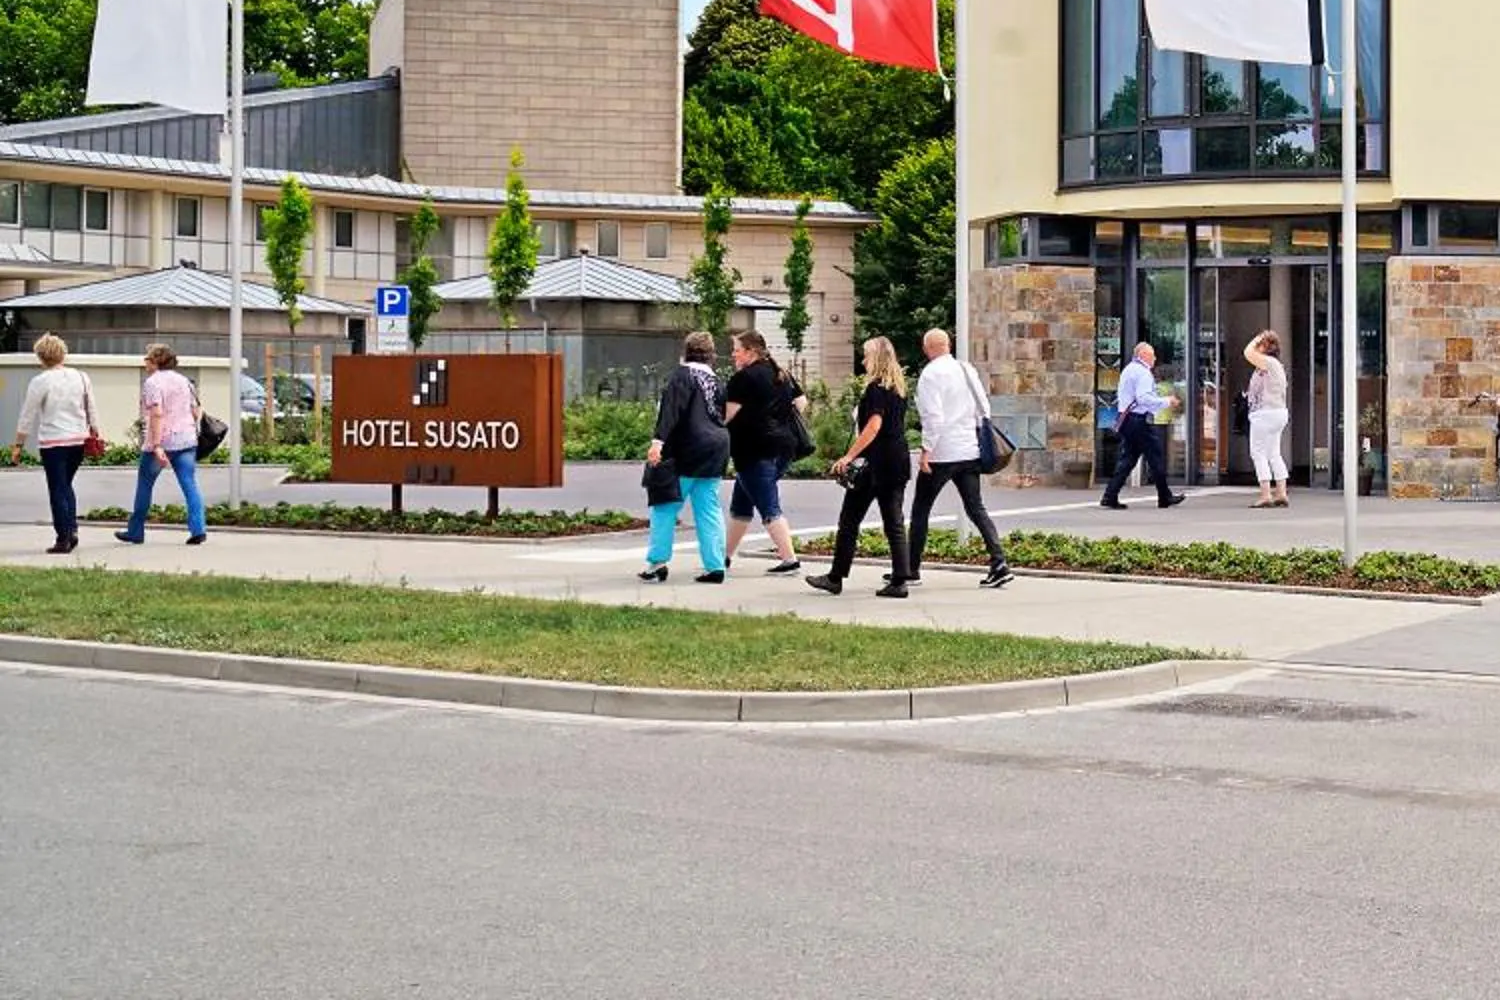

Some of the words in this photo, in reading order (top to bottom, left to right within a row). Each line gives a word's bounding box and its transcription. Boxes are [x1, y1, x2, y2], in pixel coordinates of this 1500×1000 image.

[383, 290, 401, 313] P
[342, 420, 418, 447] HOTEL
[424, 420, 519, 449] SUSATO
